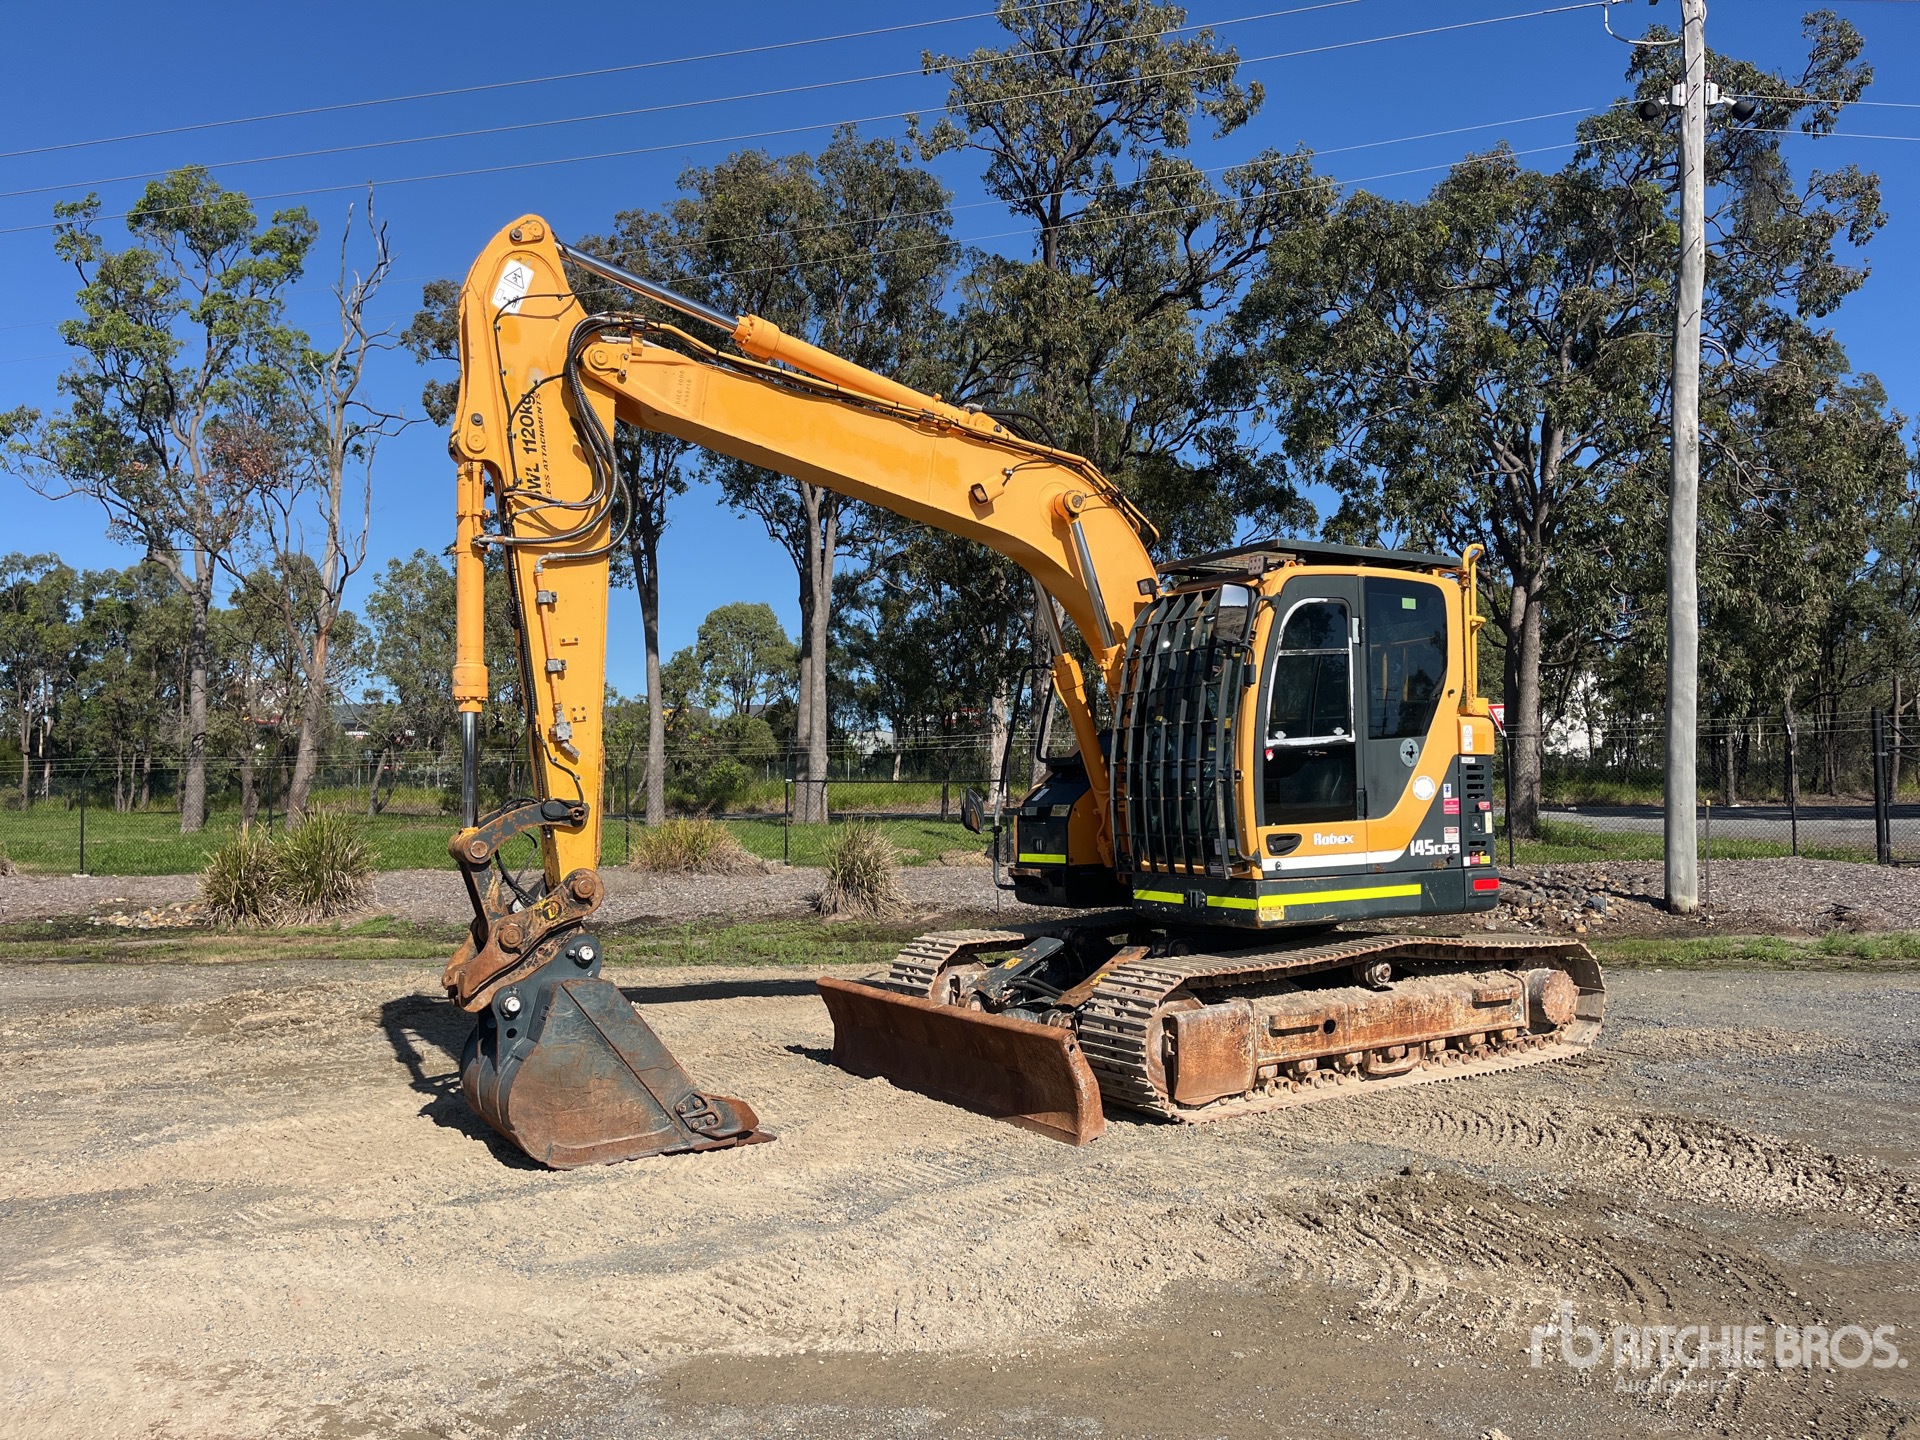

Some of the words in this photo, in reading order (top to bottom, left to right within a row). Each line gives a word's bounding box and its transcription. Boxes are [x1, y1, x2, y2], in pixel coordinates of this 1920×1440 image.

[518, 392, 538, 455] 1120kg
[534, 391, 550, 472] ATTACHMENTS
[524, 461, 543, 501] WL
[542, 473, 552, 499] ESS
[1313, 833, 1355, 846] Robex
